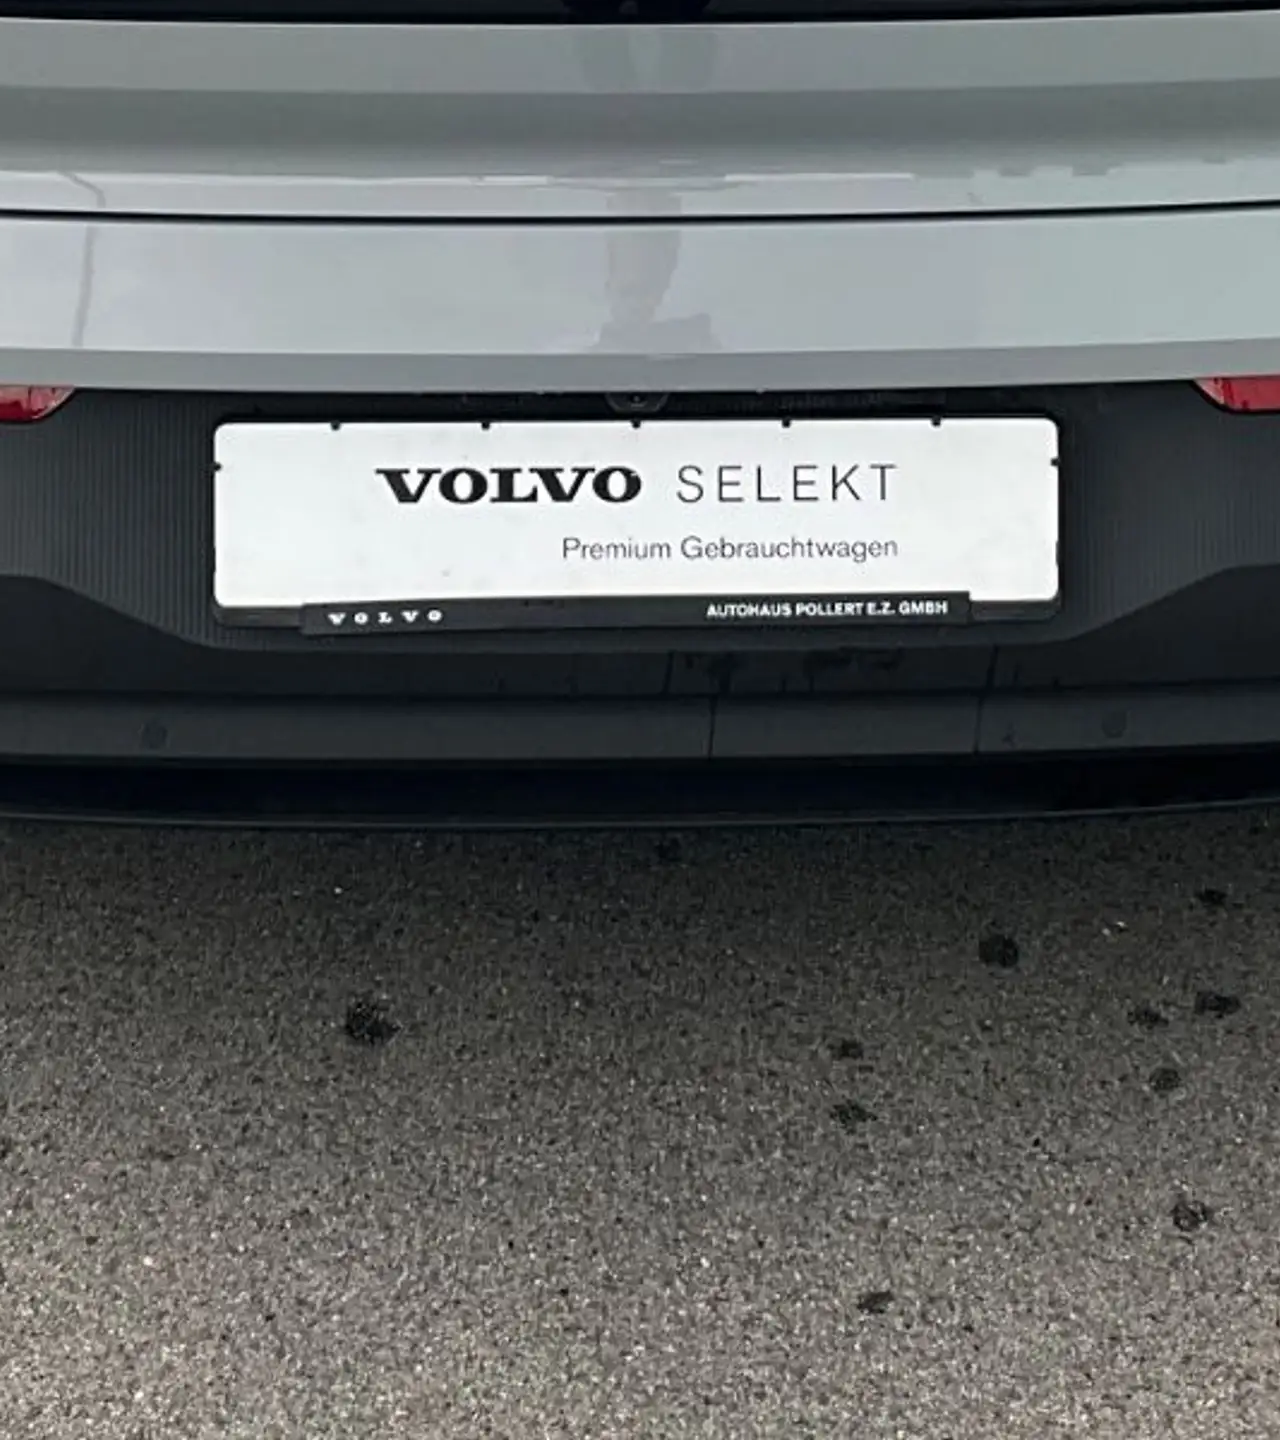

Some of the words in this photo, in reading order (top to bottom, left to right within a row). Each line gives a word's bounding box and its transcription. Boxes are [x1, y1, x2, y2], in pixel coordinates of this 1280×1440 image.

[376, 466, 642, 503] VOLVO
[676, 465, 897, 502] SELEKT
[562, 537, 672, 559] Premium
[681, 536, 898, 561] Gebrauchtwagen
[328, 610, 443, 625] VOLVO
[706, 603, 792, 617] AUTOHAUS
[795, 602, 863, 616] POLLERT
[898, 600, 948, 615] GMBH
